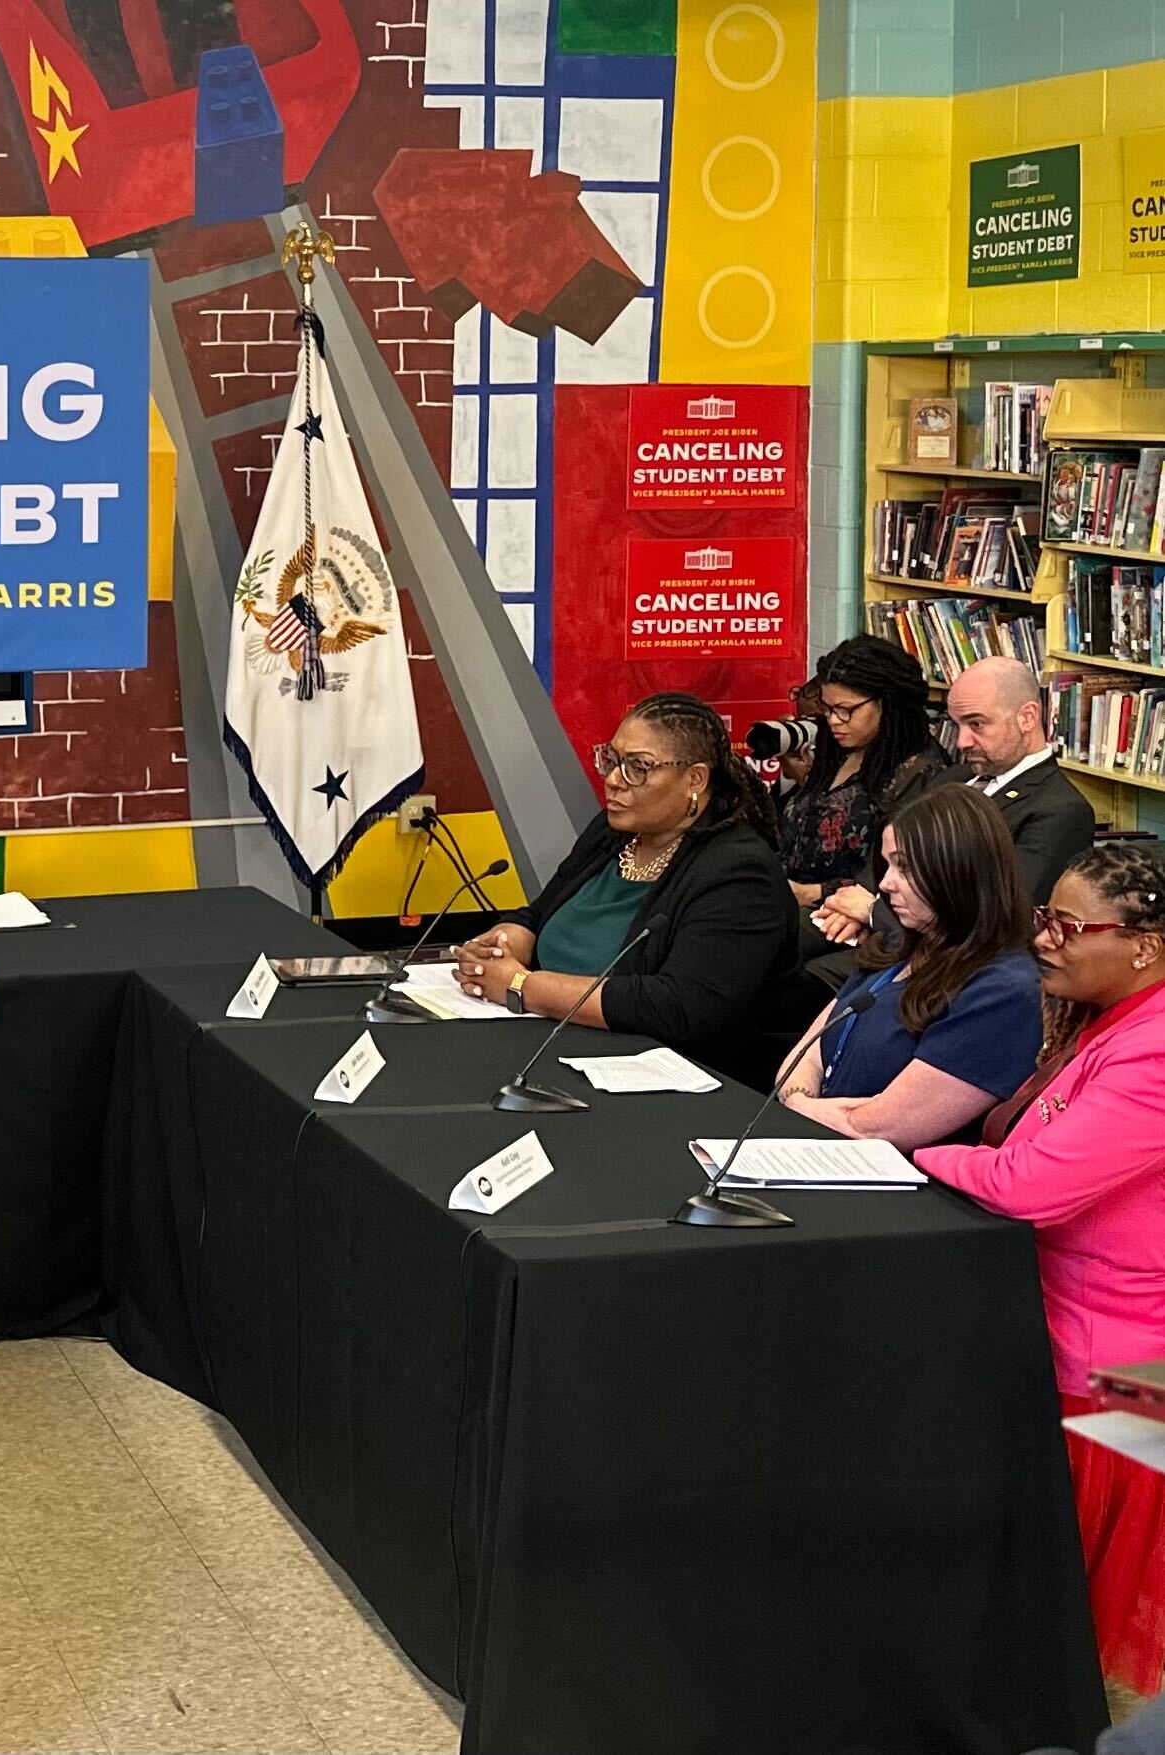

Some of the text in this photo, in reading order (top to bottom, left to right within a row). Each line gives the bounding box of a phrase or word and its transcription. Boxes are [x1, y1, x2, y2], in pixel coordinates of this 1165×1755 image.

[976, 207, 1072, 236] CANCELING
[972, 235, 1074, 259] STUDENT DEBT
[663, 429, 710, 437] PRESIDENT
[638, 442, 783, 461] CANCELING
[634, 468, 786, 483] STUDENT DEBT
[633, 490, 654, 498] VICE
[711, 489, 748, 497] KAMALA
[660, 580, 708, 588] PRESIDENT
[729, 579, 755, 587] BIDEN
[636, 592, 780, 612] CANCELING
[632, 618, 783, 634] STUDENT DEBT
[655, 640, 705, 648] PRESIDENT
